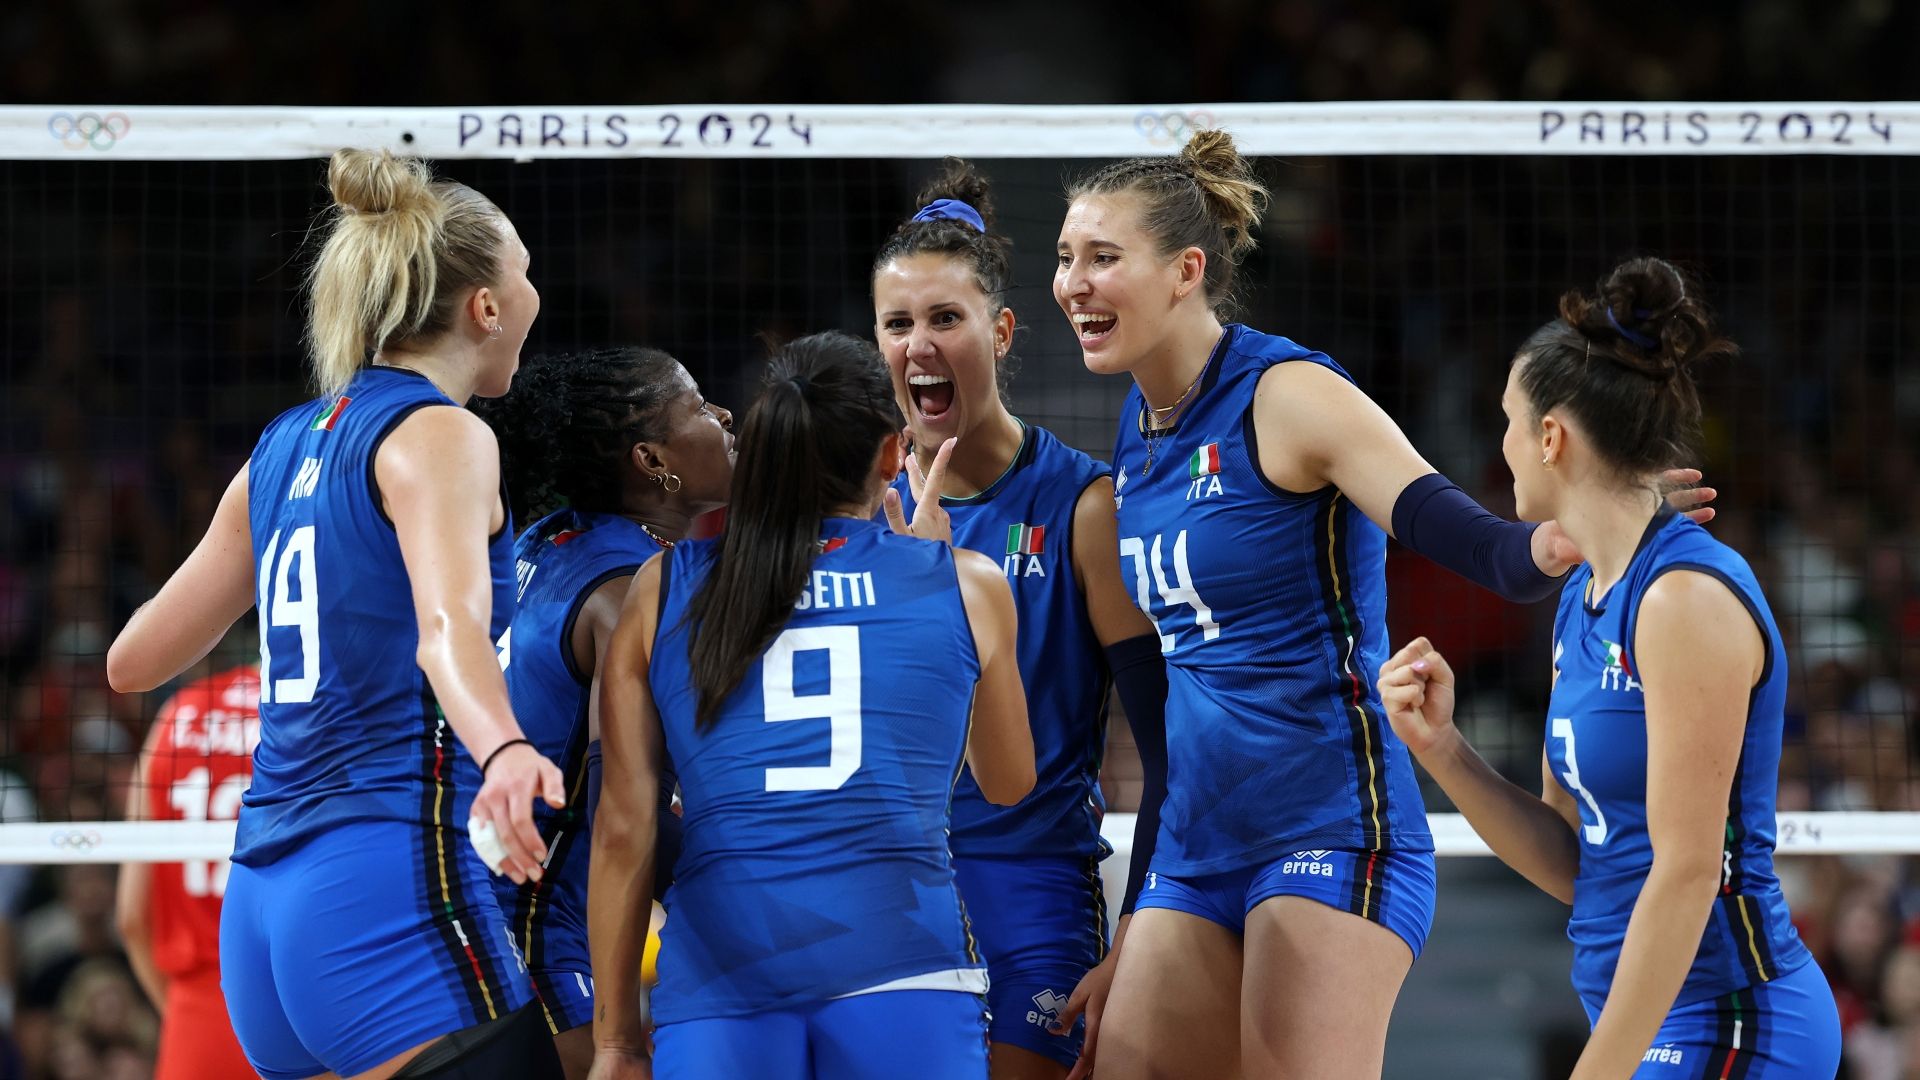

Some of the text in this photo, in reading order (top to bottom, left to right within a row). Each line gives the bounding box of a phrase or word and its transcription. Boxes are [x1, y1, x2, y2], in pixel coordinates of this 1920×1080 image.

[459, 113, 812, 148] PARIS 2024
[1539, 110, 1891, 144] PARIS 2024
[1186, 474, 1223, 501] ITA
[1003, 553, 1046, 578] ITA
[259, 525, 320, 704] 19
[763, 625, 862, 792] 9
[1552, 718, 1607, 845] 3
[1781, 821, 1822, 844] 24
